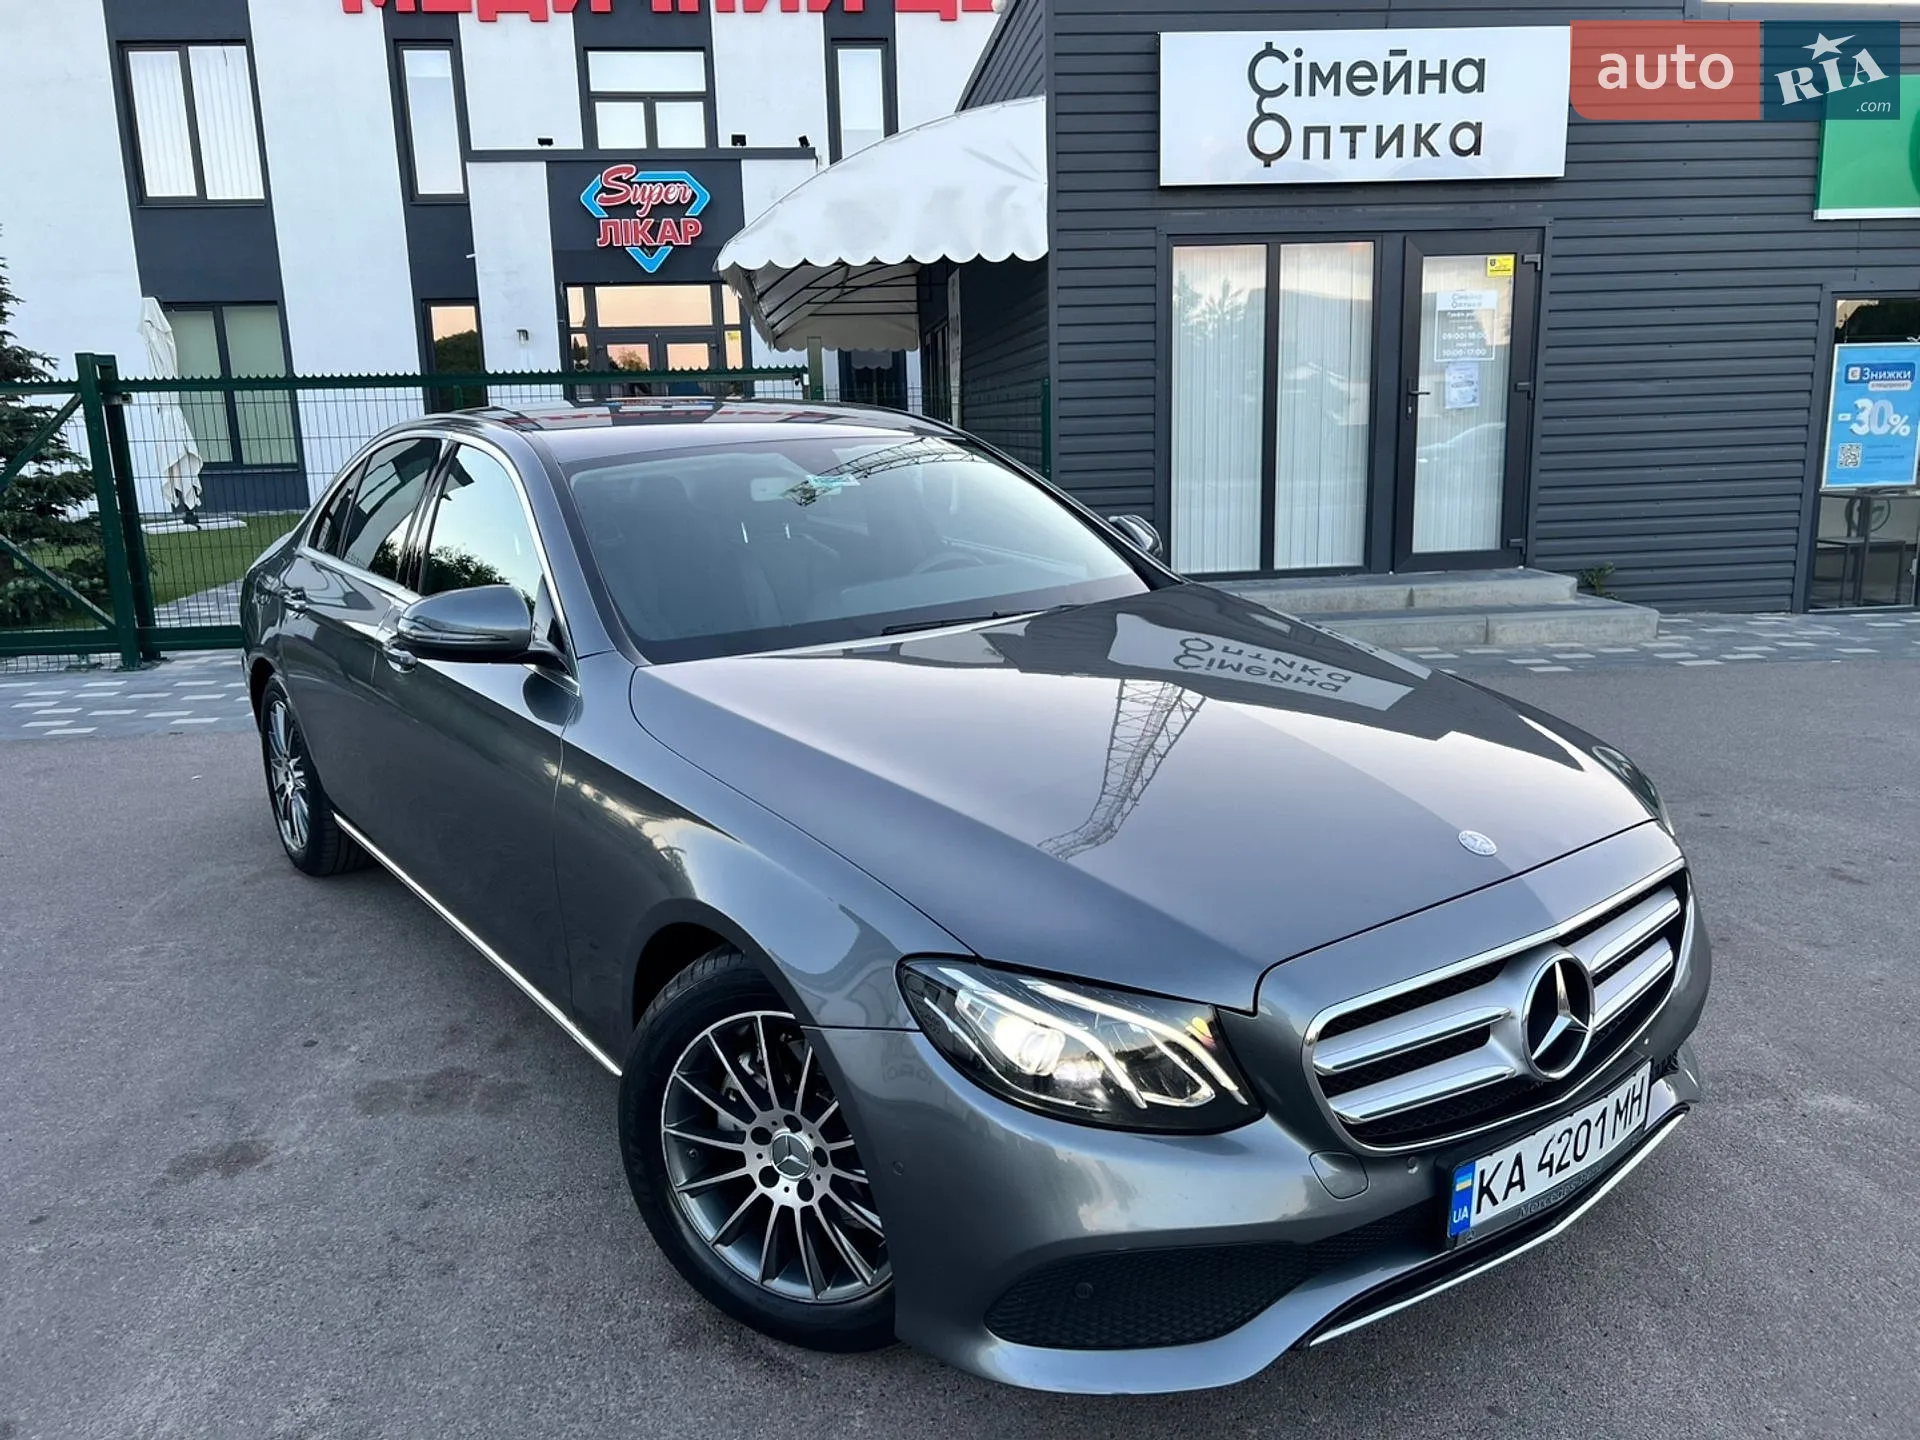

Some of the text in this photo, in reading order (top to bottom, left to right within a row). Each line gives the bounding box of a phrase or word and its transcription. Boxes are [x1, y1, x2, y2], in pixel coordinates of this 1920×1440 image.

[1247, 42, 1486, 98] Сімейна
[1247, 112, 1483, 168] Оптика
[597, 163, 693, 218] Super
[597, 217, 703, 248] ЛІКАР
[1862, 367, 1911, 381] Знижки
[1838, 397, 1911, 437] -30%
[1475, 1075, 1645, 1215] KA 4201 MH
[1453, 1205, 1469, 1224] UA
